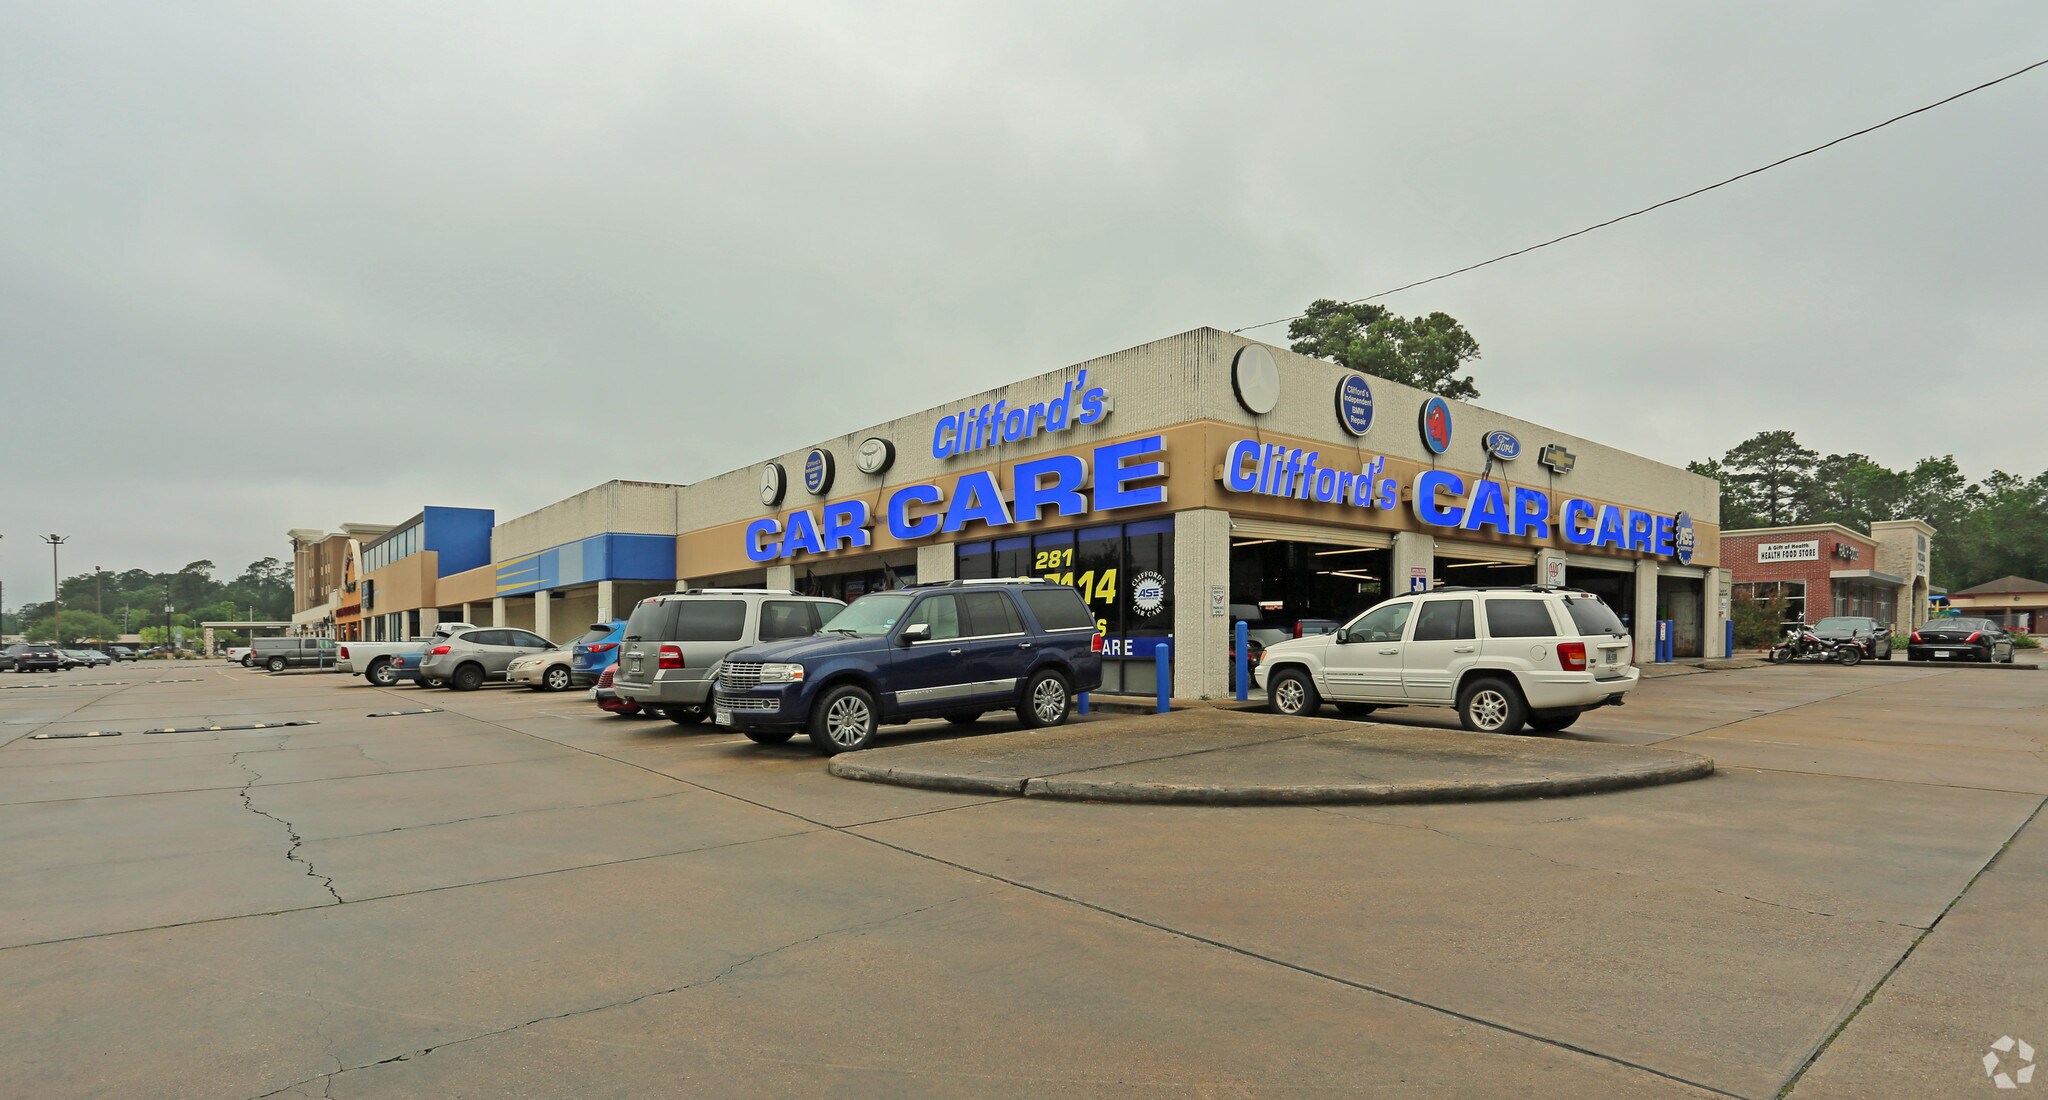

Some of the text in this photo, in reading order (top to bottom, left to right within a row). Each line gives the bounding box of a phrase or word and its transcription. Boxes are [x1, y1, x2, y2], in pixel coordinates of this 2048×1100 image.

[1344, 393, 1372, 407] Independent
[1346, 385, 1369, 398] Clifford's
[932, 369, 1108, 460] Clifford's
[1350, 415, 1366, 425] Repair
[1497, 434, 1515, 454] Ford
[1225, 439, 1398, 511] Clifford's
[746, 435, 1168, 563] CAR CARE
[1413, 469, 1674, 556] CAR CARE
[1680, 527, 1693, 546] ASE
[1761, 548, 1816, 560] HEALTH FOOD STORE
[1791, 542, 1809, 550] Health
[1035, 548, 1073, 570] 281
[1131, 570, 1167, 587] CLIFFORD'S
[1138, 588, 1160, 597] ASE
[1132, 604, 1165, 618] CAR CARE
[1101, 639, 1134, 656] ARE
